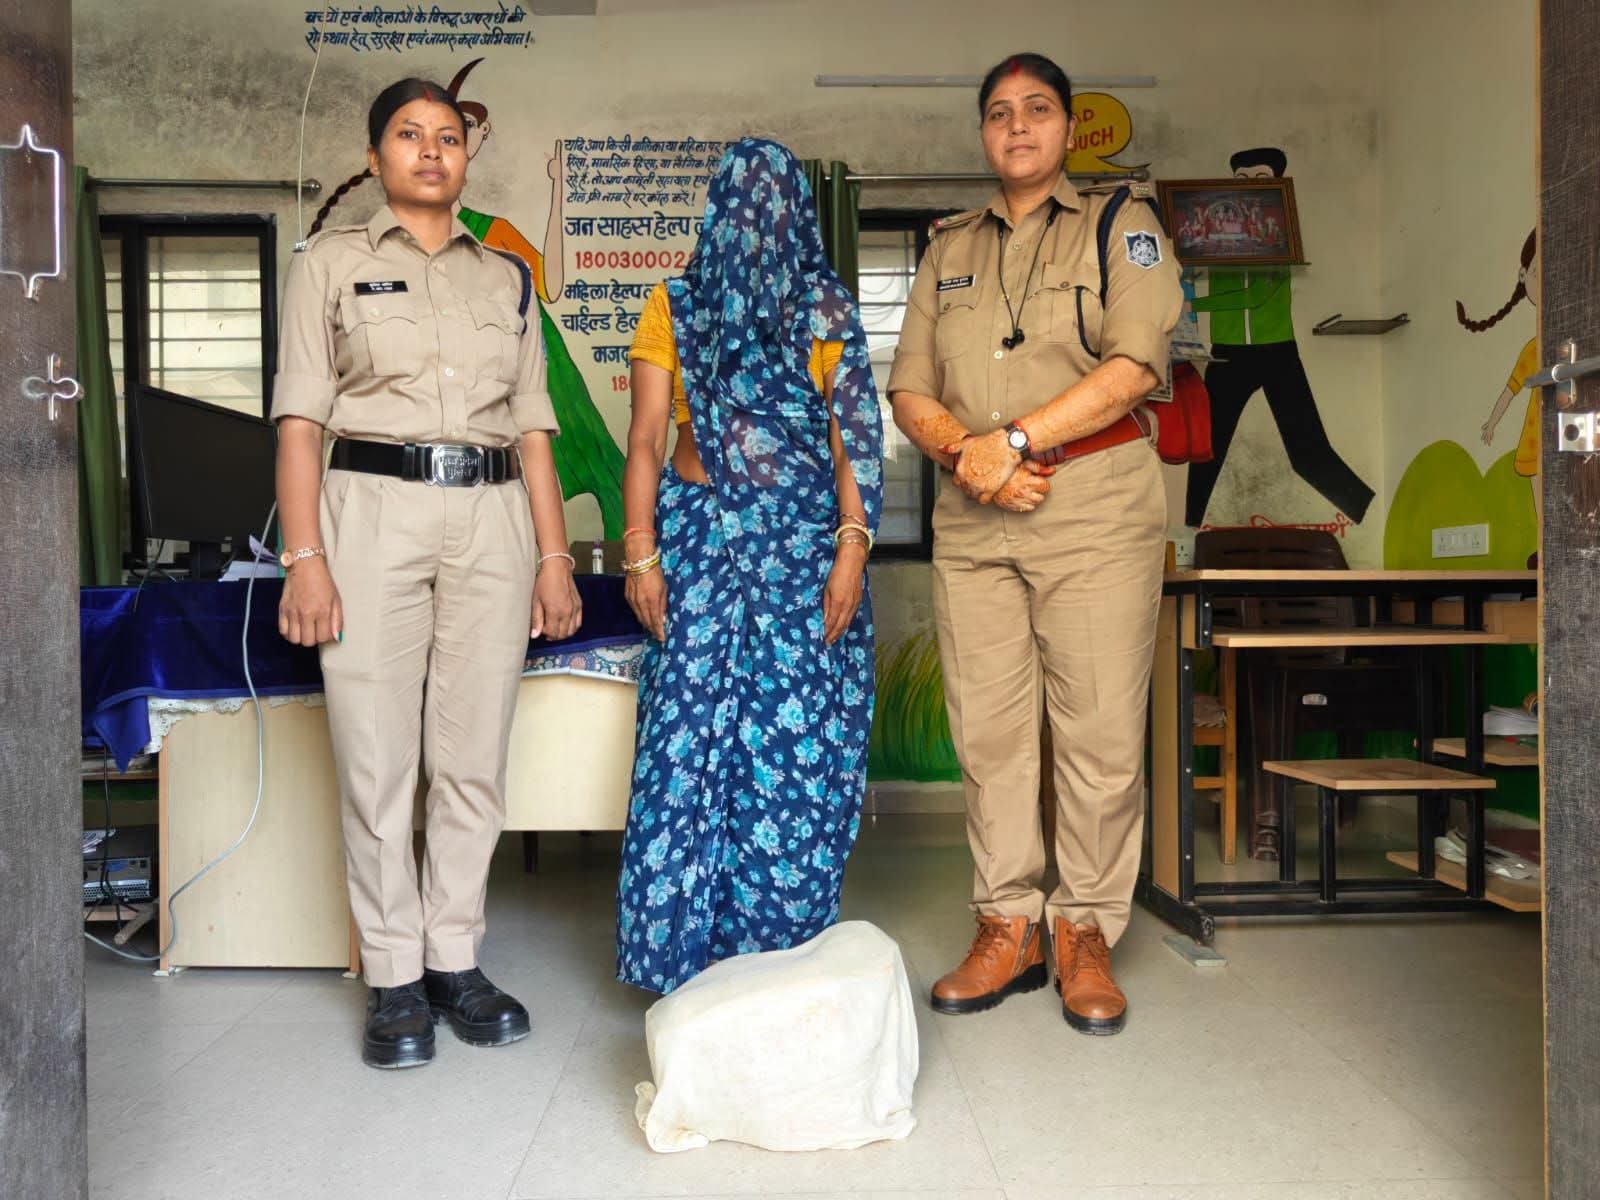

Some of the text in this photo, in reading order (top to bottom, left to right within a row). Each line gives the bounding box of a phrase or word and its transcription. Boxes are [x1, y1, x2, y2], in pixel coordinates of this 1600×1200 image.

[565, 217, 597, 237] जन
[597, 217, 653, 239] साहस
[653, 211, 692, 240] हेल्प
[576, 251, 695, 269] 180030002
[565, 279, 610, 302] महिला
[610, 279, 643, 304] हेल्प
